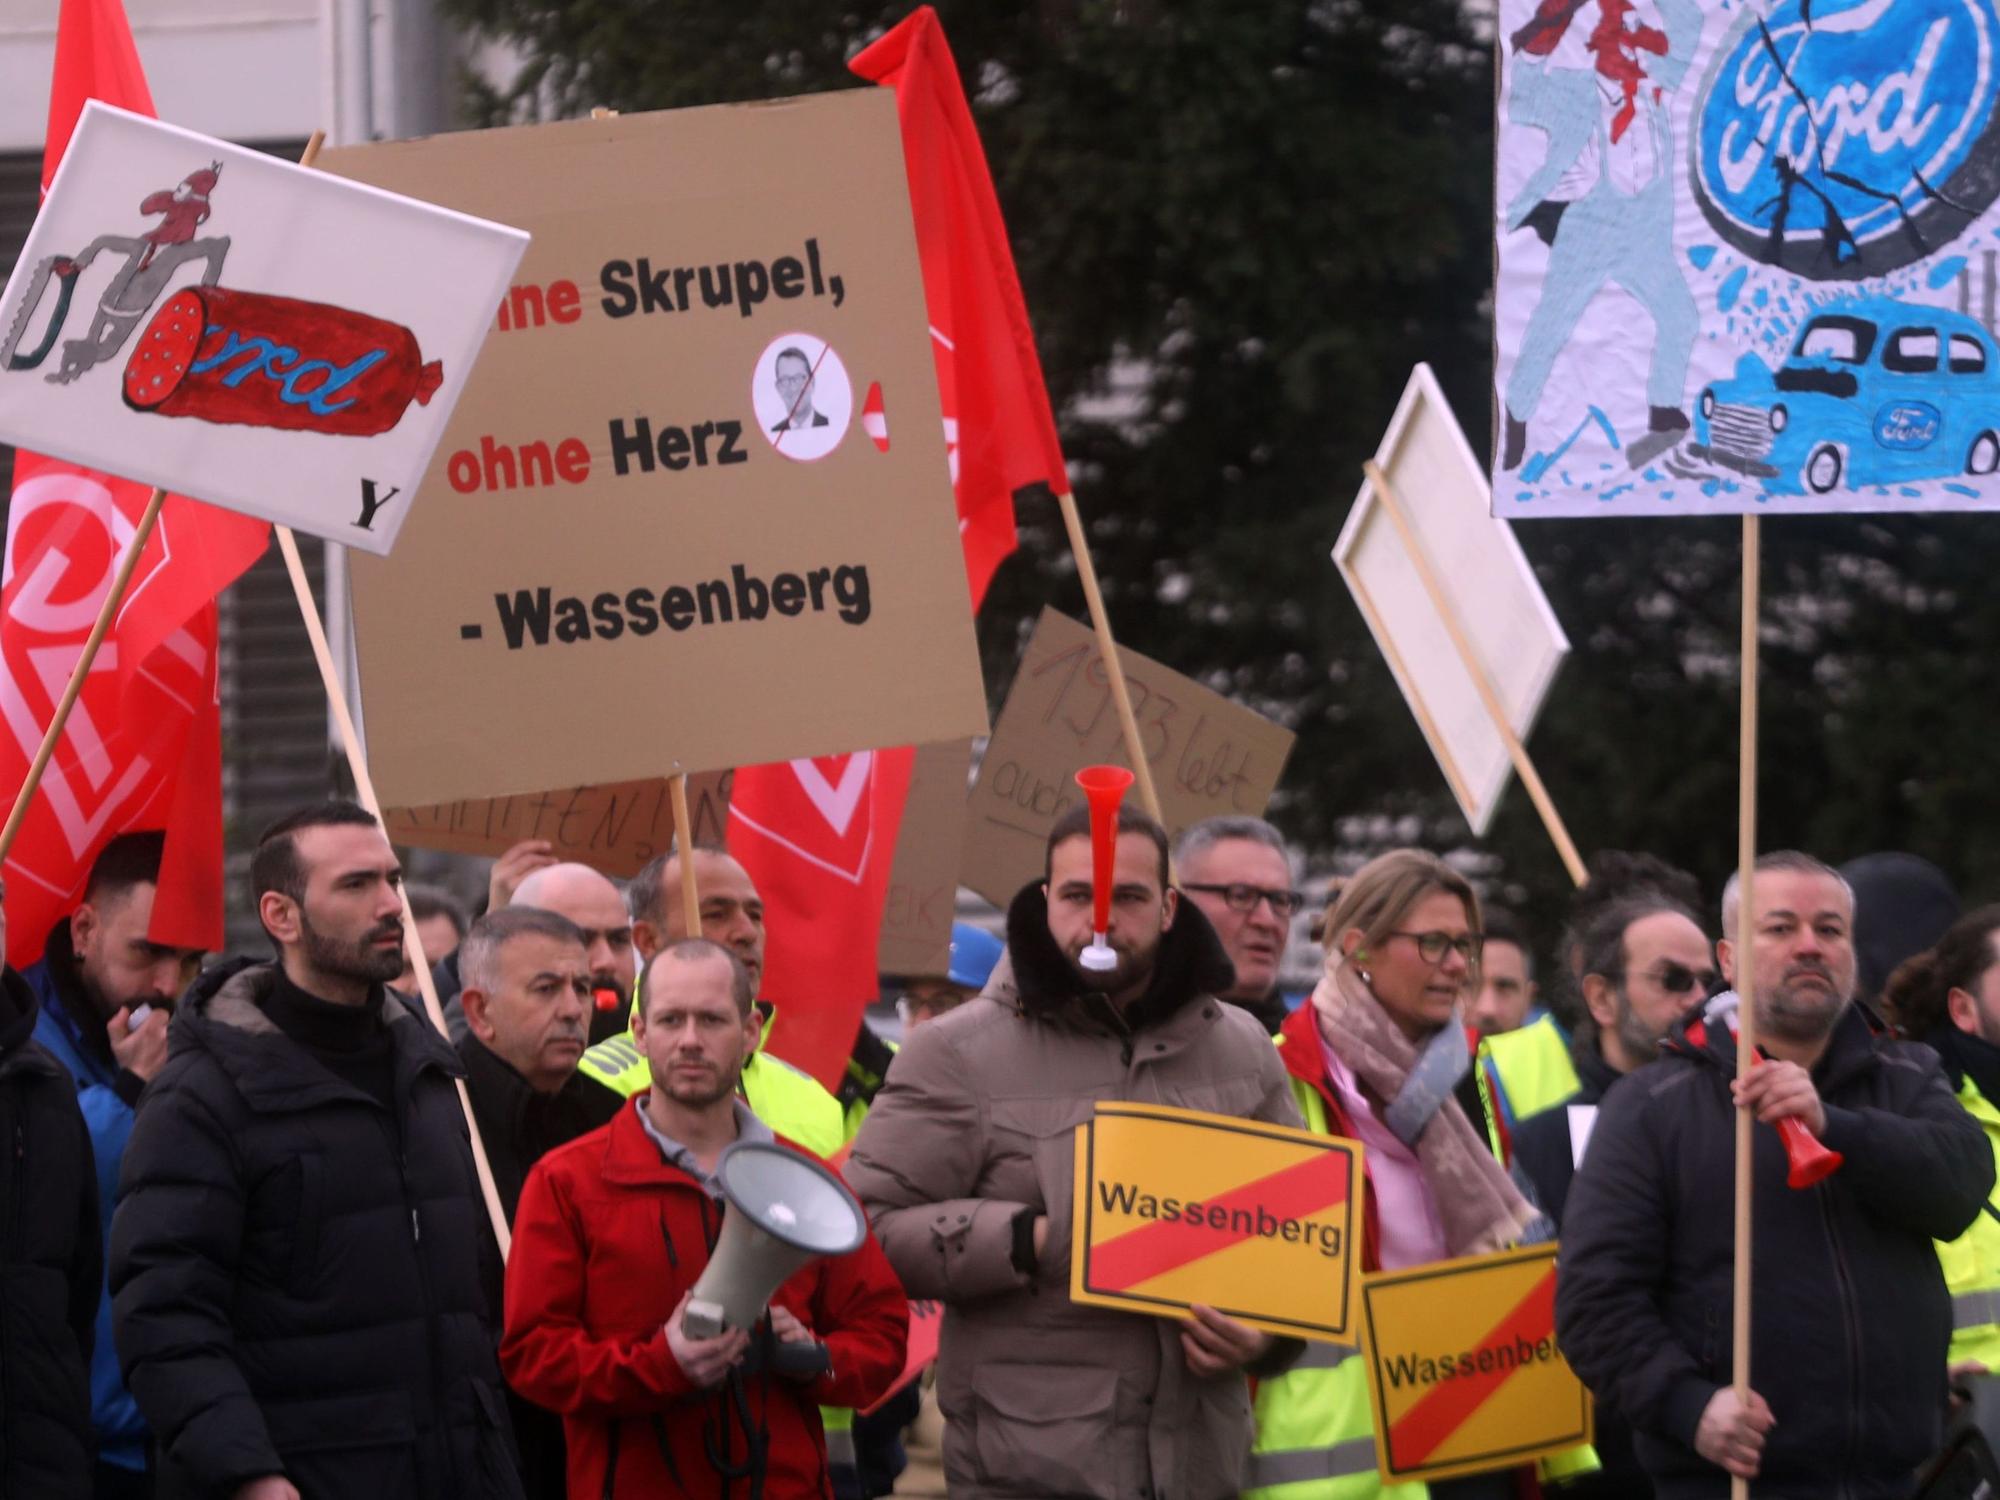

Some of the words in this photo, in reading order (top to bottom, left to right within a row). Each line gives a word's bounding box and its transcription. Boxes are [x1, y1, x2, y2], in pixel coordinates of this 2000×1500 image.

[1718, 0, 1950, 194] Ford
[498, 279, 582, 332] ne
[600, 238, 844, 319] Skrupel,
[447, 435, 592, 494] ohne
[608, 416, 749, 476] Herz
[350, 477, 401, 532] Y
[494, 563, 873, 650] Wassenberg
[1098, 1180, 1342, 1258] Wassenberg
[1383, 1333, 1560, 1389] Wassenbe
